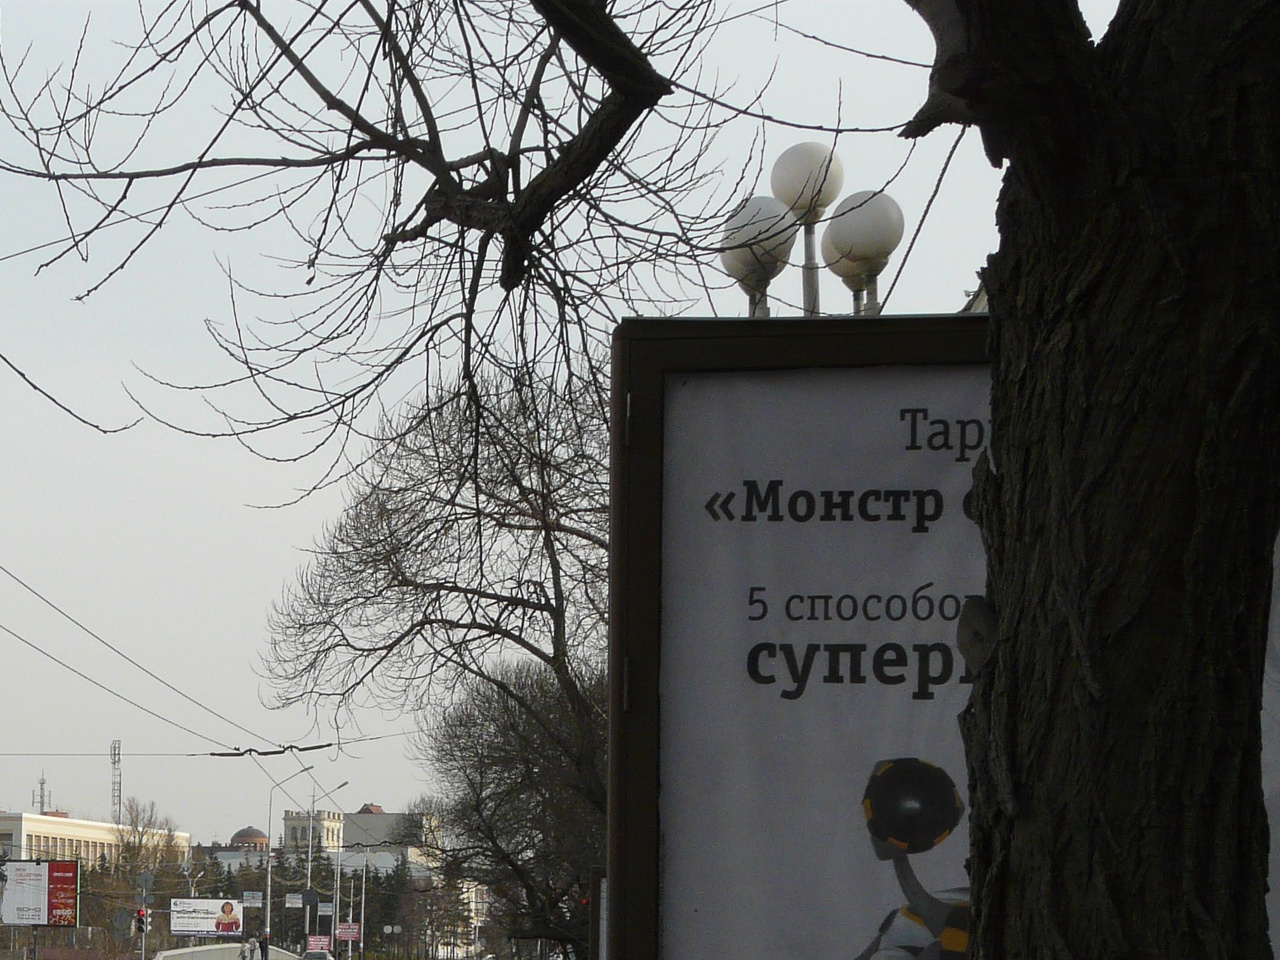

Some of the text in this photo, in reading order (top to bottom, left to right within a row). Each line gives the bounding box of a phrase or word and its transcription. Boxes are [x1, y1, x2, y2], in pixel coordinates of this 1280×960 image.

[900, 408, 991, 462] Тар
[704, 479, 944, 533] «Монстр
[748, 582, 985, 621] 5 способо
[746, 642, 974, 700] супер
